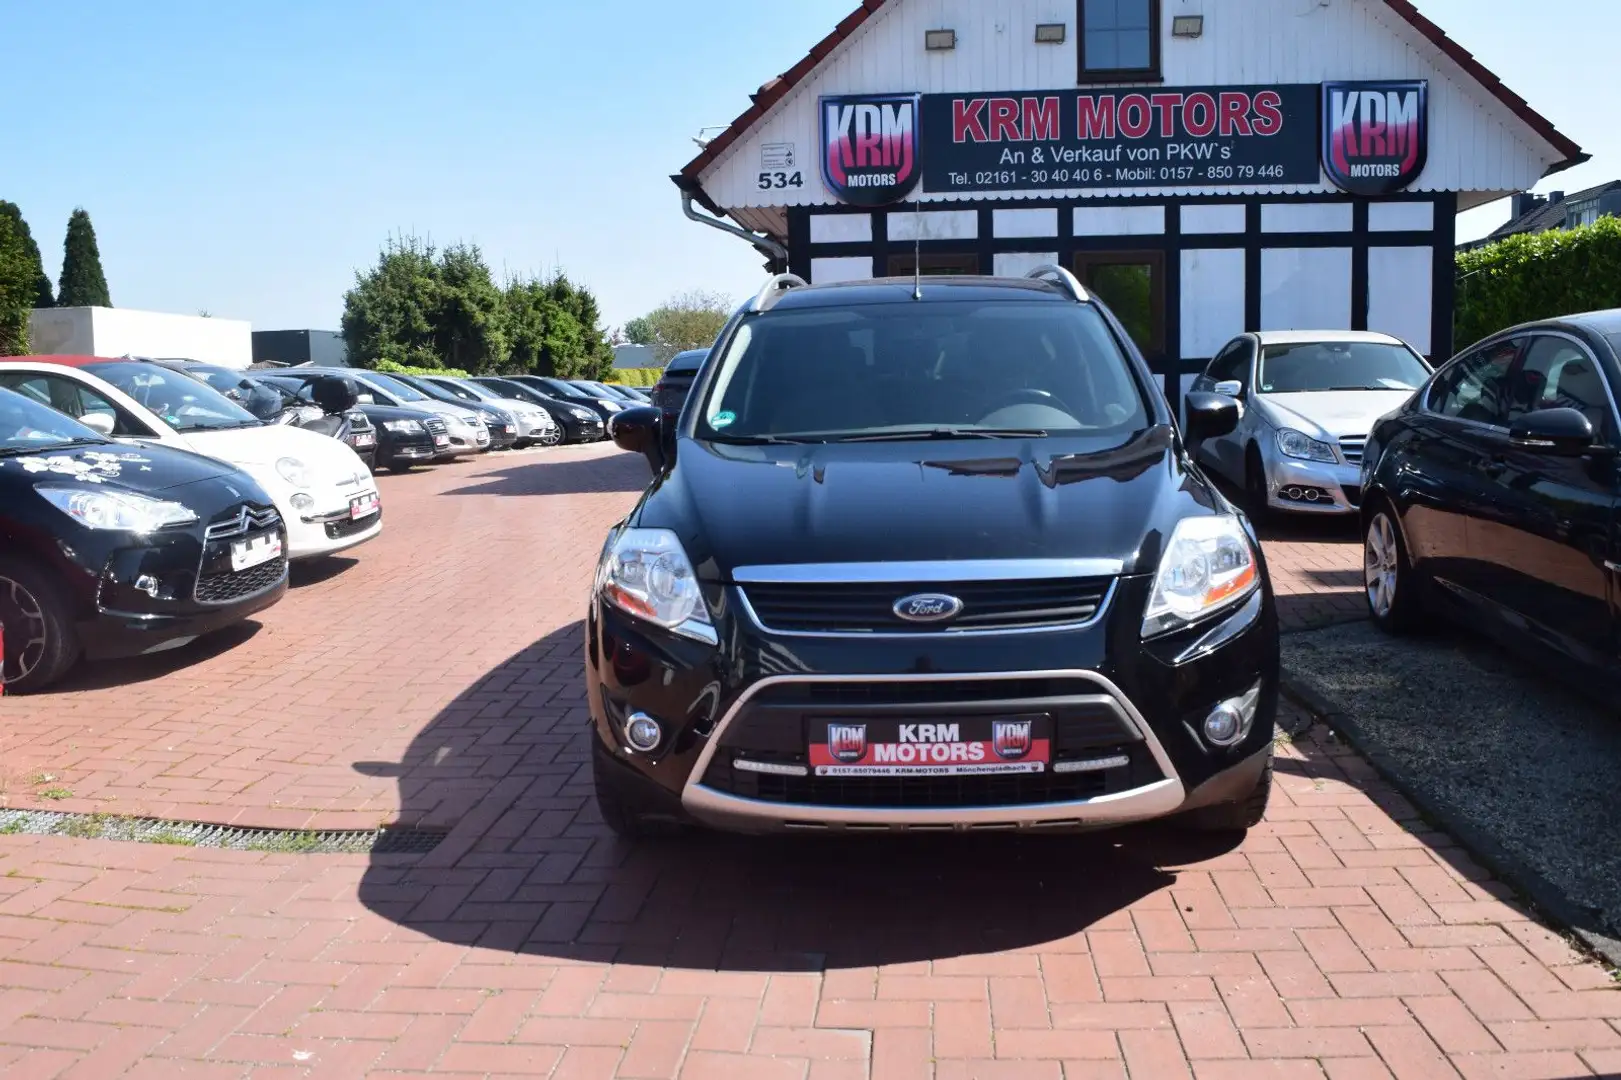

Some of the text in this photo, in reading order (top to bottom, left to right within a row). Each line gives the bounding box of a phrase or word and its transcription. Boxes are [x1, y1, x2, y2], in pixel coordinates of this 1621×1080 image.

[952, 91, 1283, 144] KRM MOTORS
[1331, 91, 1418, 157] KRM
[827, 104, 913, 168] KRM
[999, 147, 1025, 165] An
[1031, 147, 1045, 163] &
[1051, 144, 1122, 163] Verkauf
[1126, 147, 1160, 162] von
[758, 171, 803, 190] 534
[847, 173, 897, 188] MOTORS
[949, 171, 972, 185] Tel.
[975, 171, 1017, 184] 02161
[1031, 170, 1048, 183] 30
[1051, 169, 1069, 182] 40
[1072, 169, 1090, 182] 40
[1093, 168, 1103, 181] 6
[1116, 166, 1156, 181] Mobil:
[1159, 167, 1194, 180] 0157
[1207, 166, 1233, 179] 850
[1236, 165, 1254, 178] 79
[1258, 164, 1284, 178] 446
[1350, 163, 1400, 178] MOTORS
[908, 598, 945, 615] Ford
[899, 724, 960, 743] KRM
[874, 742, 985, 762] MOTORS
